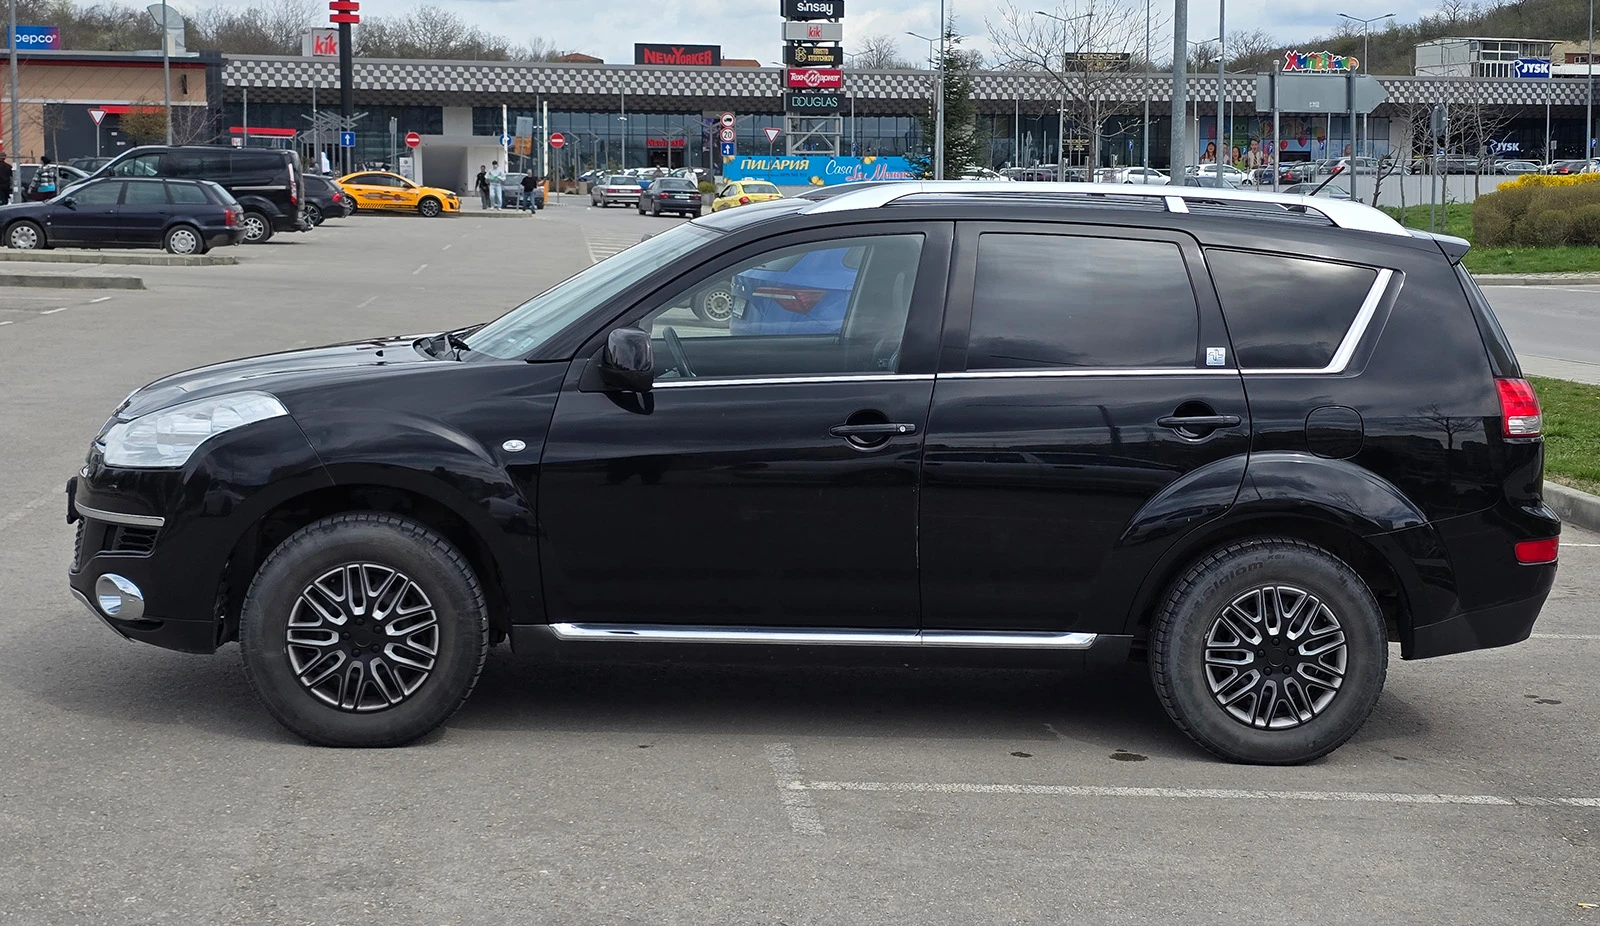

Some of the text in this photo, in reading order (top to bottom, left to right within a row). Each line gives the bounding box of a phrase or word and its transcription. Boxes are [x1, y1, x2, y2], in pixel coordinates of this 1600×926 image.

[797, 0, 834, 15] sinsay
[809, 26, 821, 37] kik
[314, 34, 338, 54] kik
[1522, 63, 1549, 73] JYSK
[792, 96, 838, 107] DOUGLAS
[1496, 142, 1520, 151] JYSK
[740, 159, 810, 170] ПИЦАРИЯ
[825, 160, 853, 175] Casa
